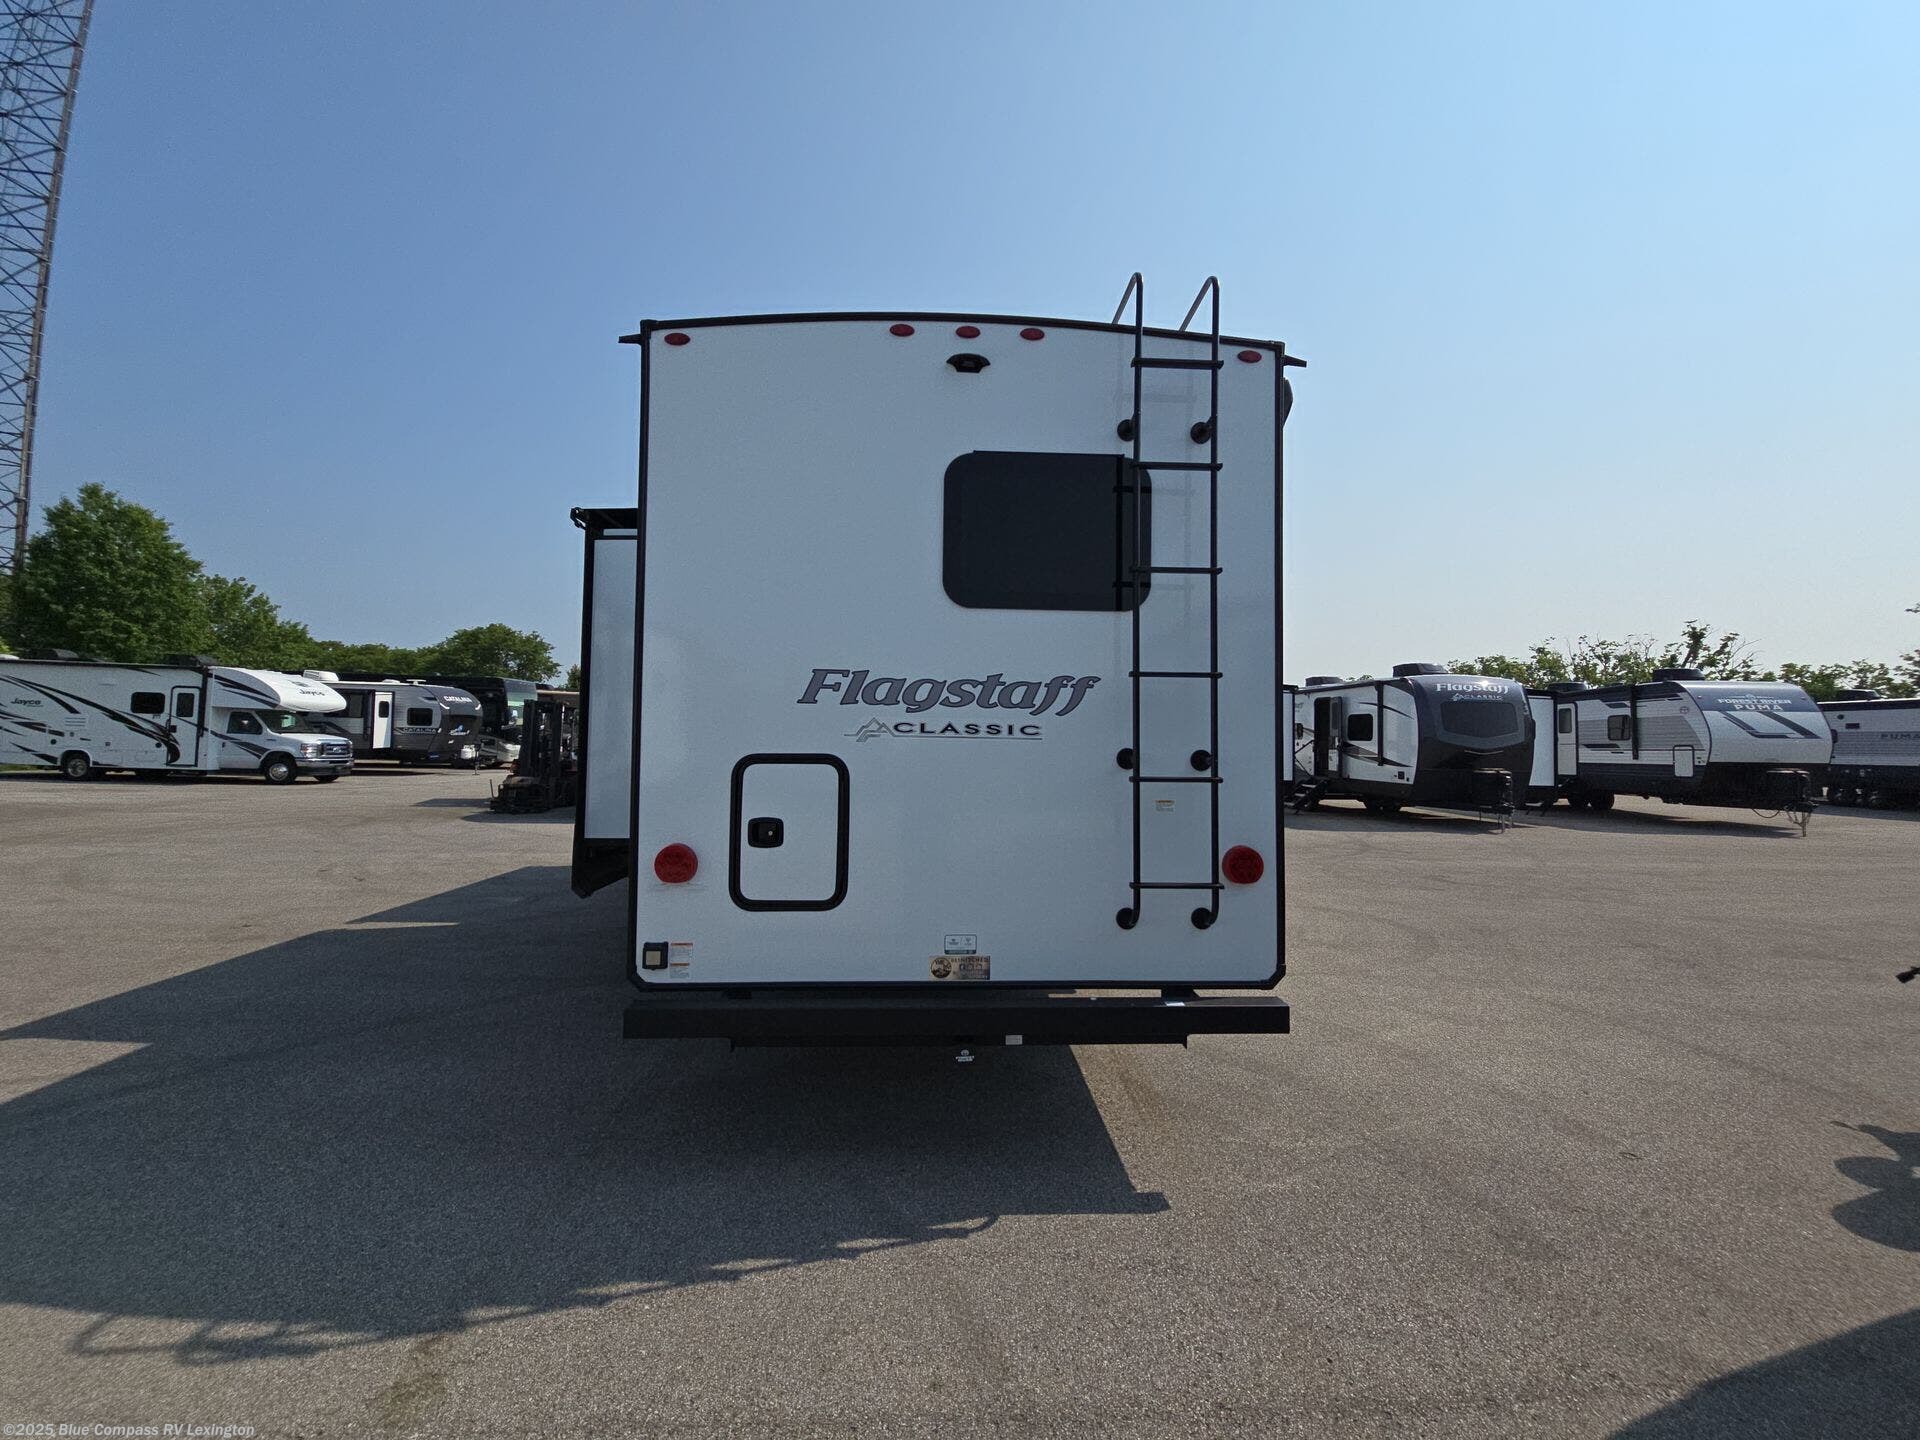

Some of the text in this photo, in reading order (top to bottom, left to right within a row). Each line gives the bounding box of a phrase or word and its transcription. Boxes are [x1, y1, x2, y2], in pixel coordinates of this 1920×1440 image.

[797, 668, 1101, 716] Flagstaff
[1436, 683, 1509, 694] Flagstaff
[893, 722, 1041, 736] CLASSIC
